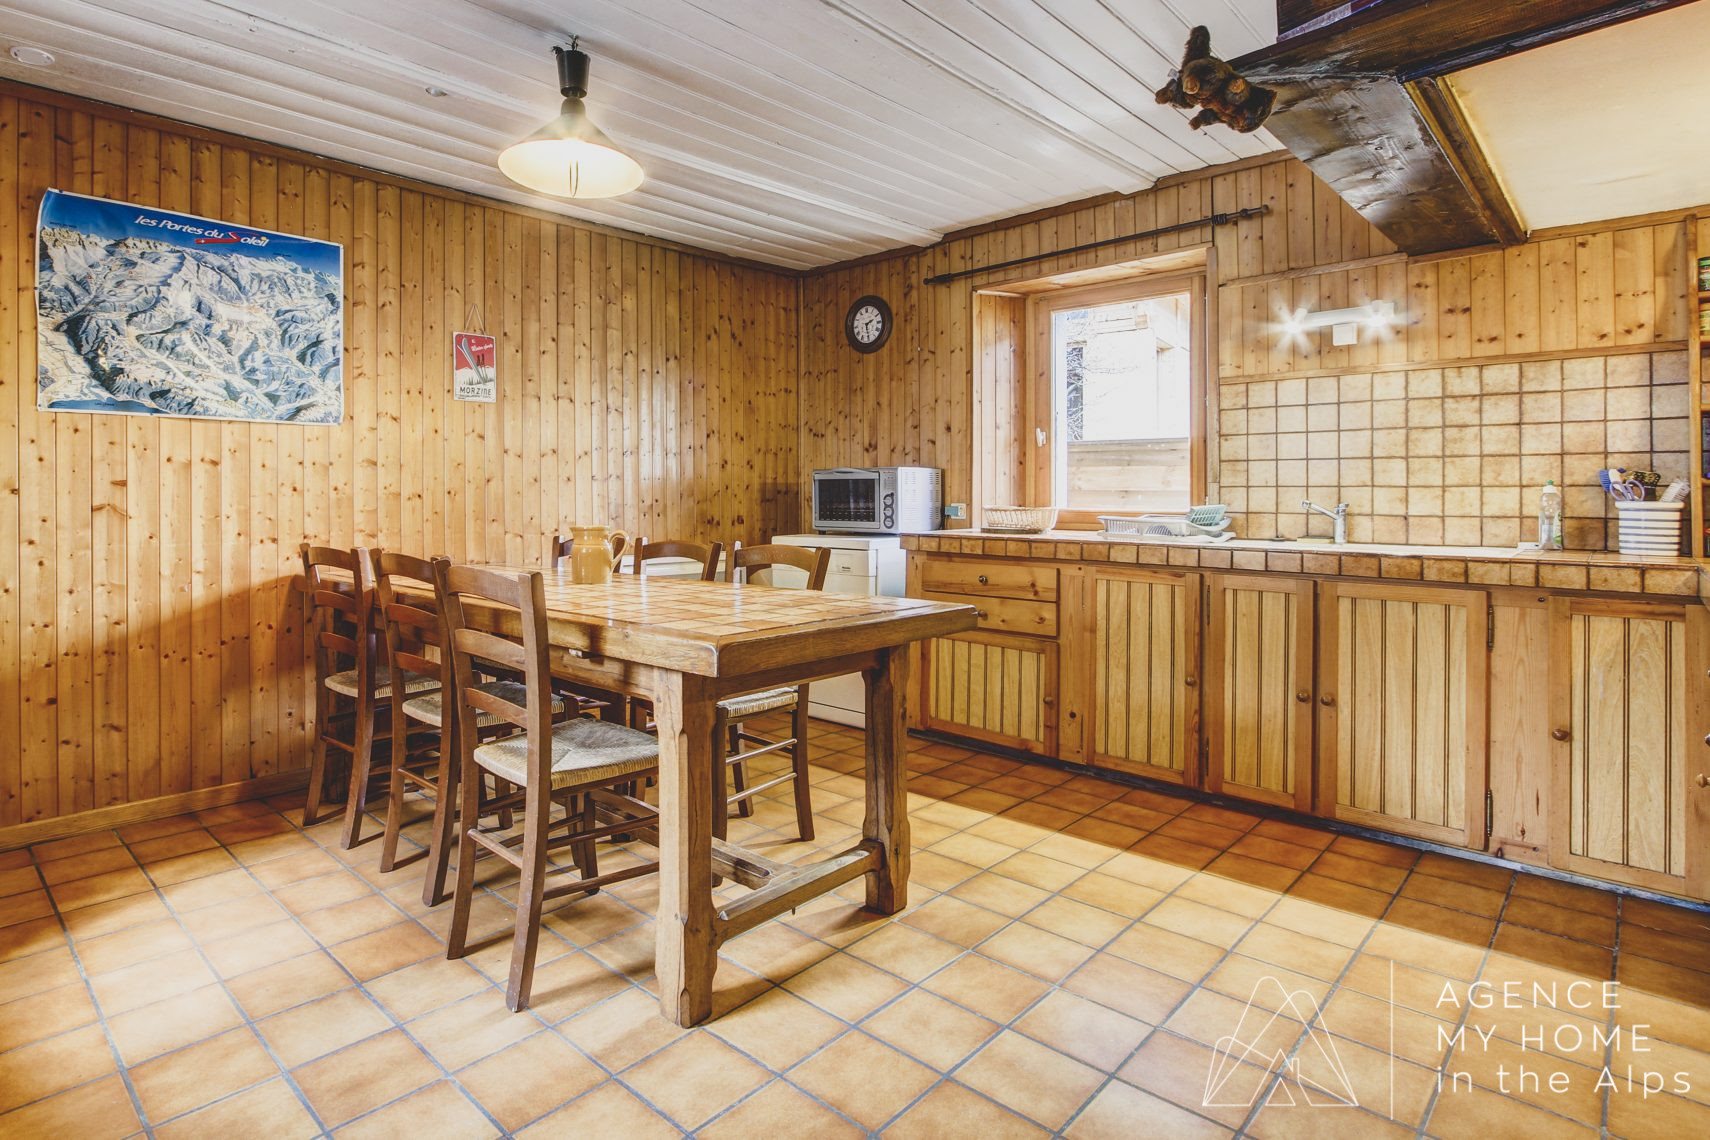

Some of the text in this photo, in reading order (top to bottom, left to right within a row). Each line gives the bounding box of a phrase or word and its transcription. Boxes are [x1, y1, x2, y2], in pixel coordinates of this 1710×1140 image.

[134, 215, 157, 227] les
[159, 219, 203, 235] Portes
[204, 228, 224, 239] du
[460, 386, 492, 395] MORZINE
